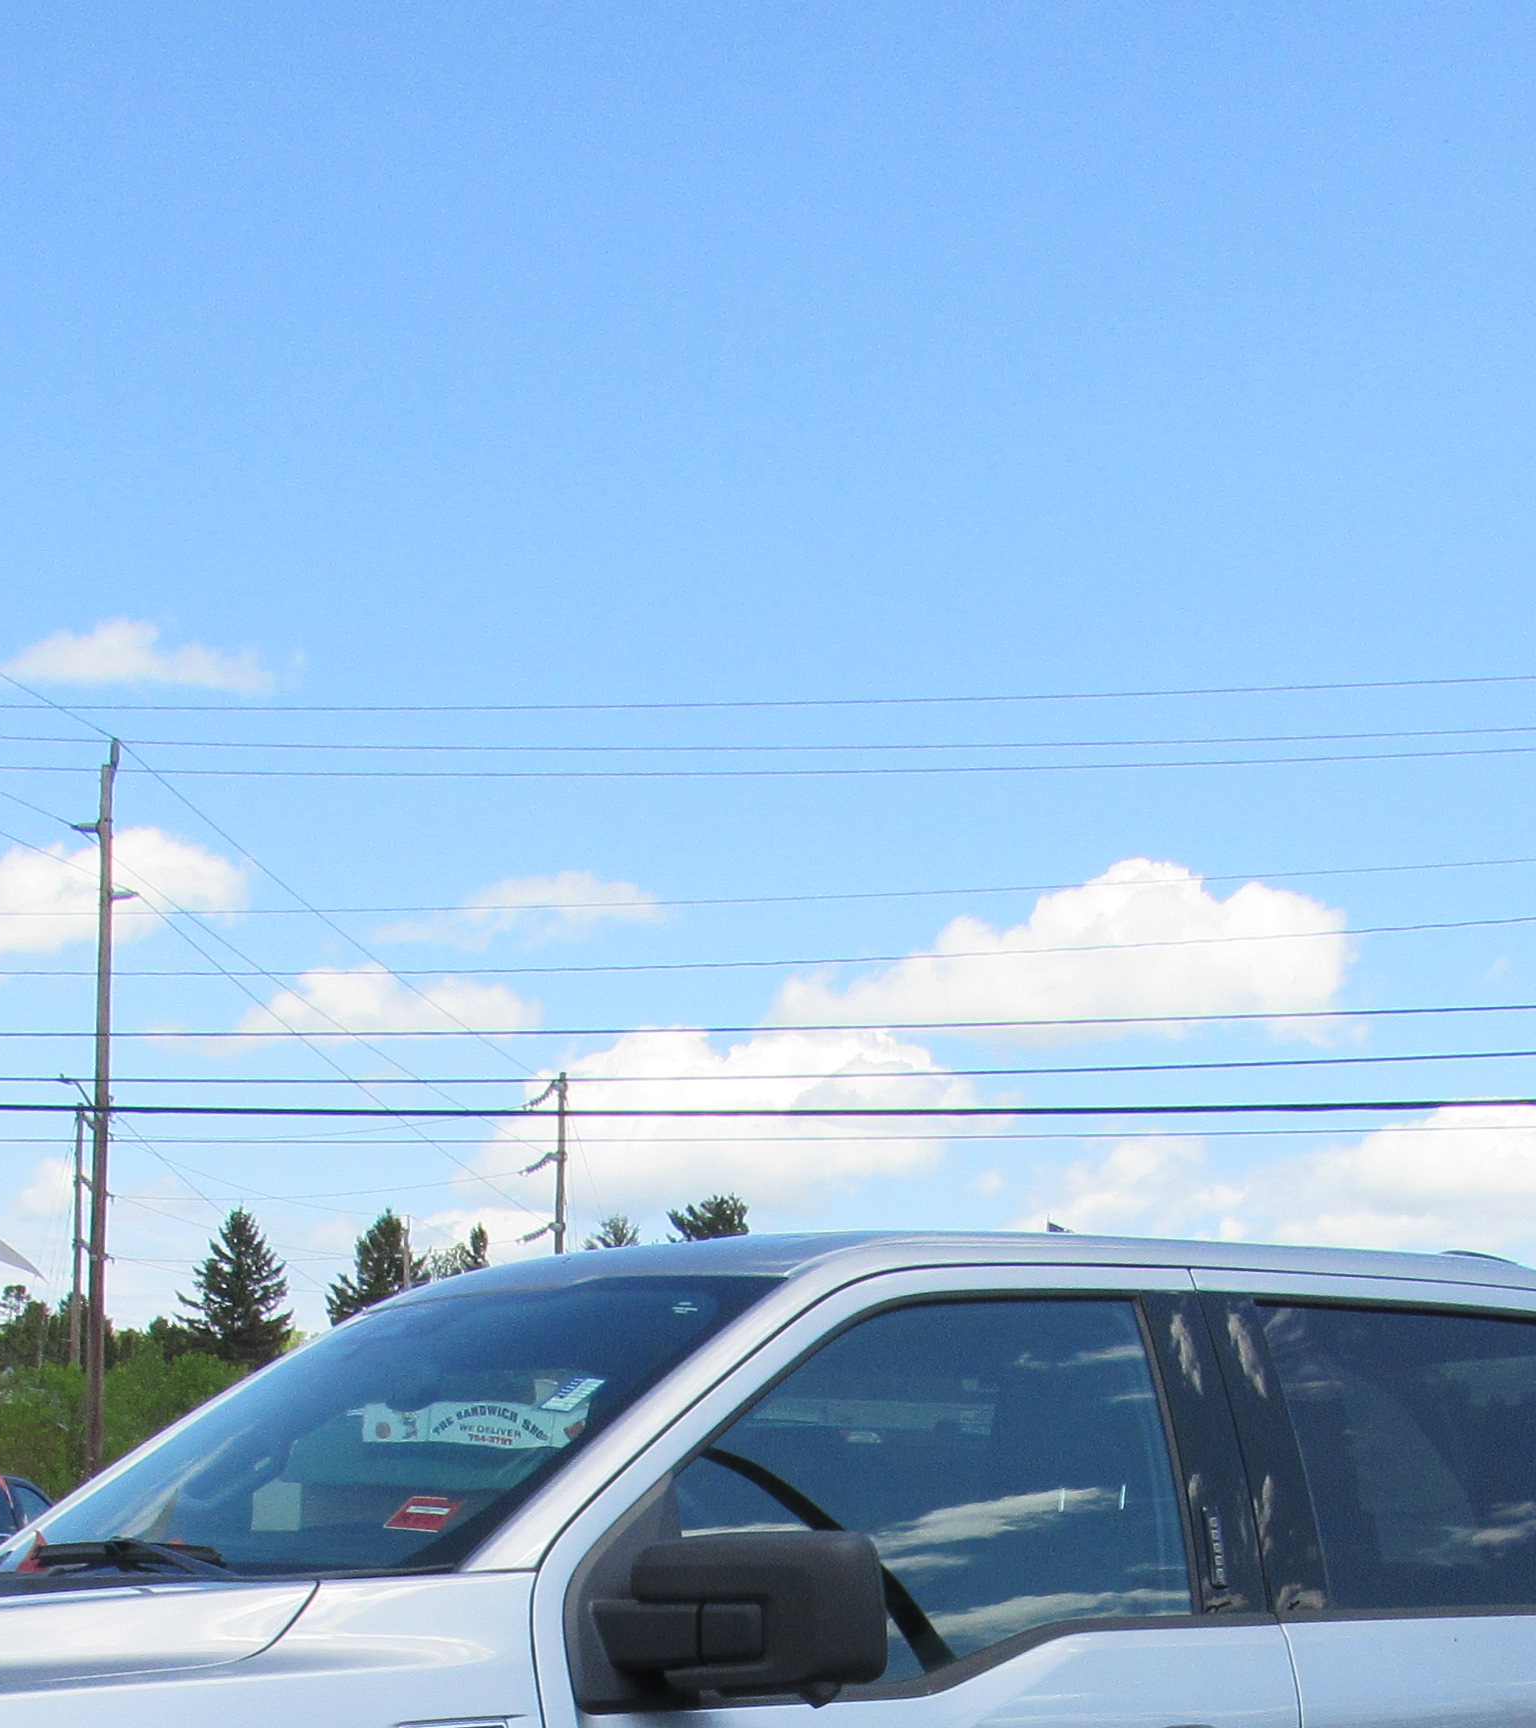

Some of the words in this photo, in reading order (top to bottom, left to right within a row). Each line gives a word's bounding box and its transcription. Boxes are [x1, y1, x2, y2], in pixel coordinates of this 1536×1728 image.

[432, 1416, 454, 1435] THE
[457, 1406, 517, 1423] SANDWICH
[477, 1426, 521, 1438] DELIVER
